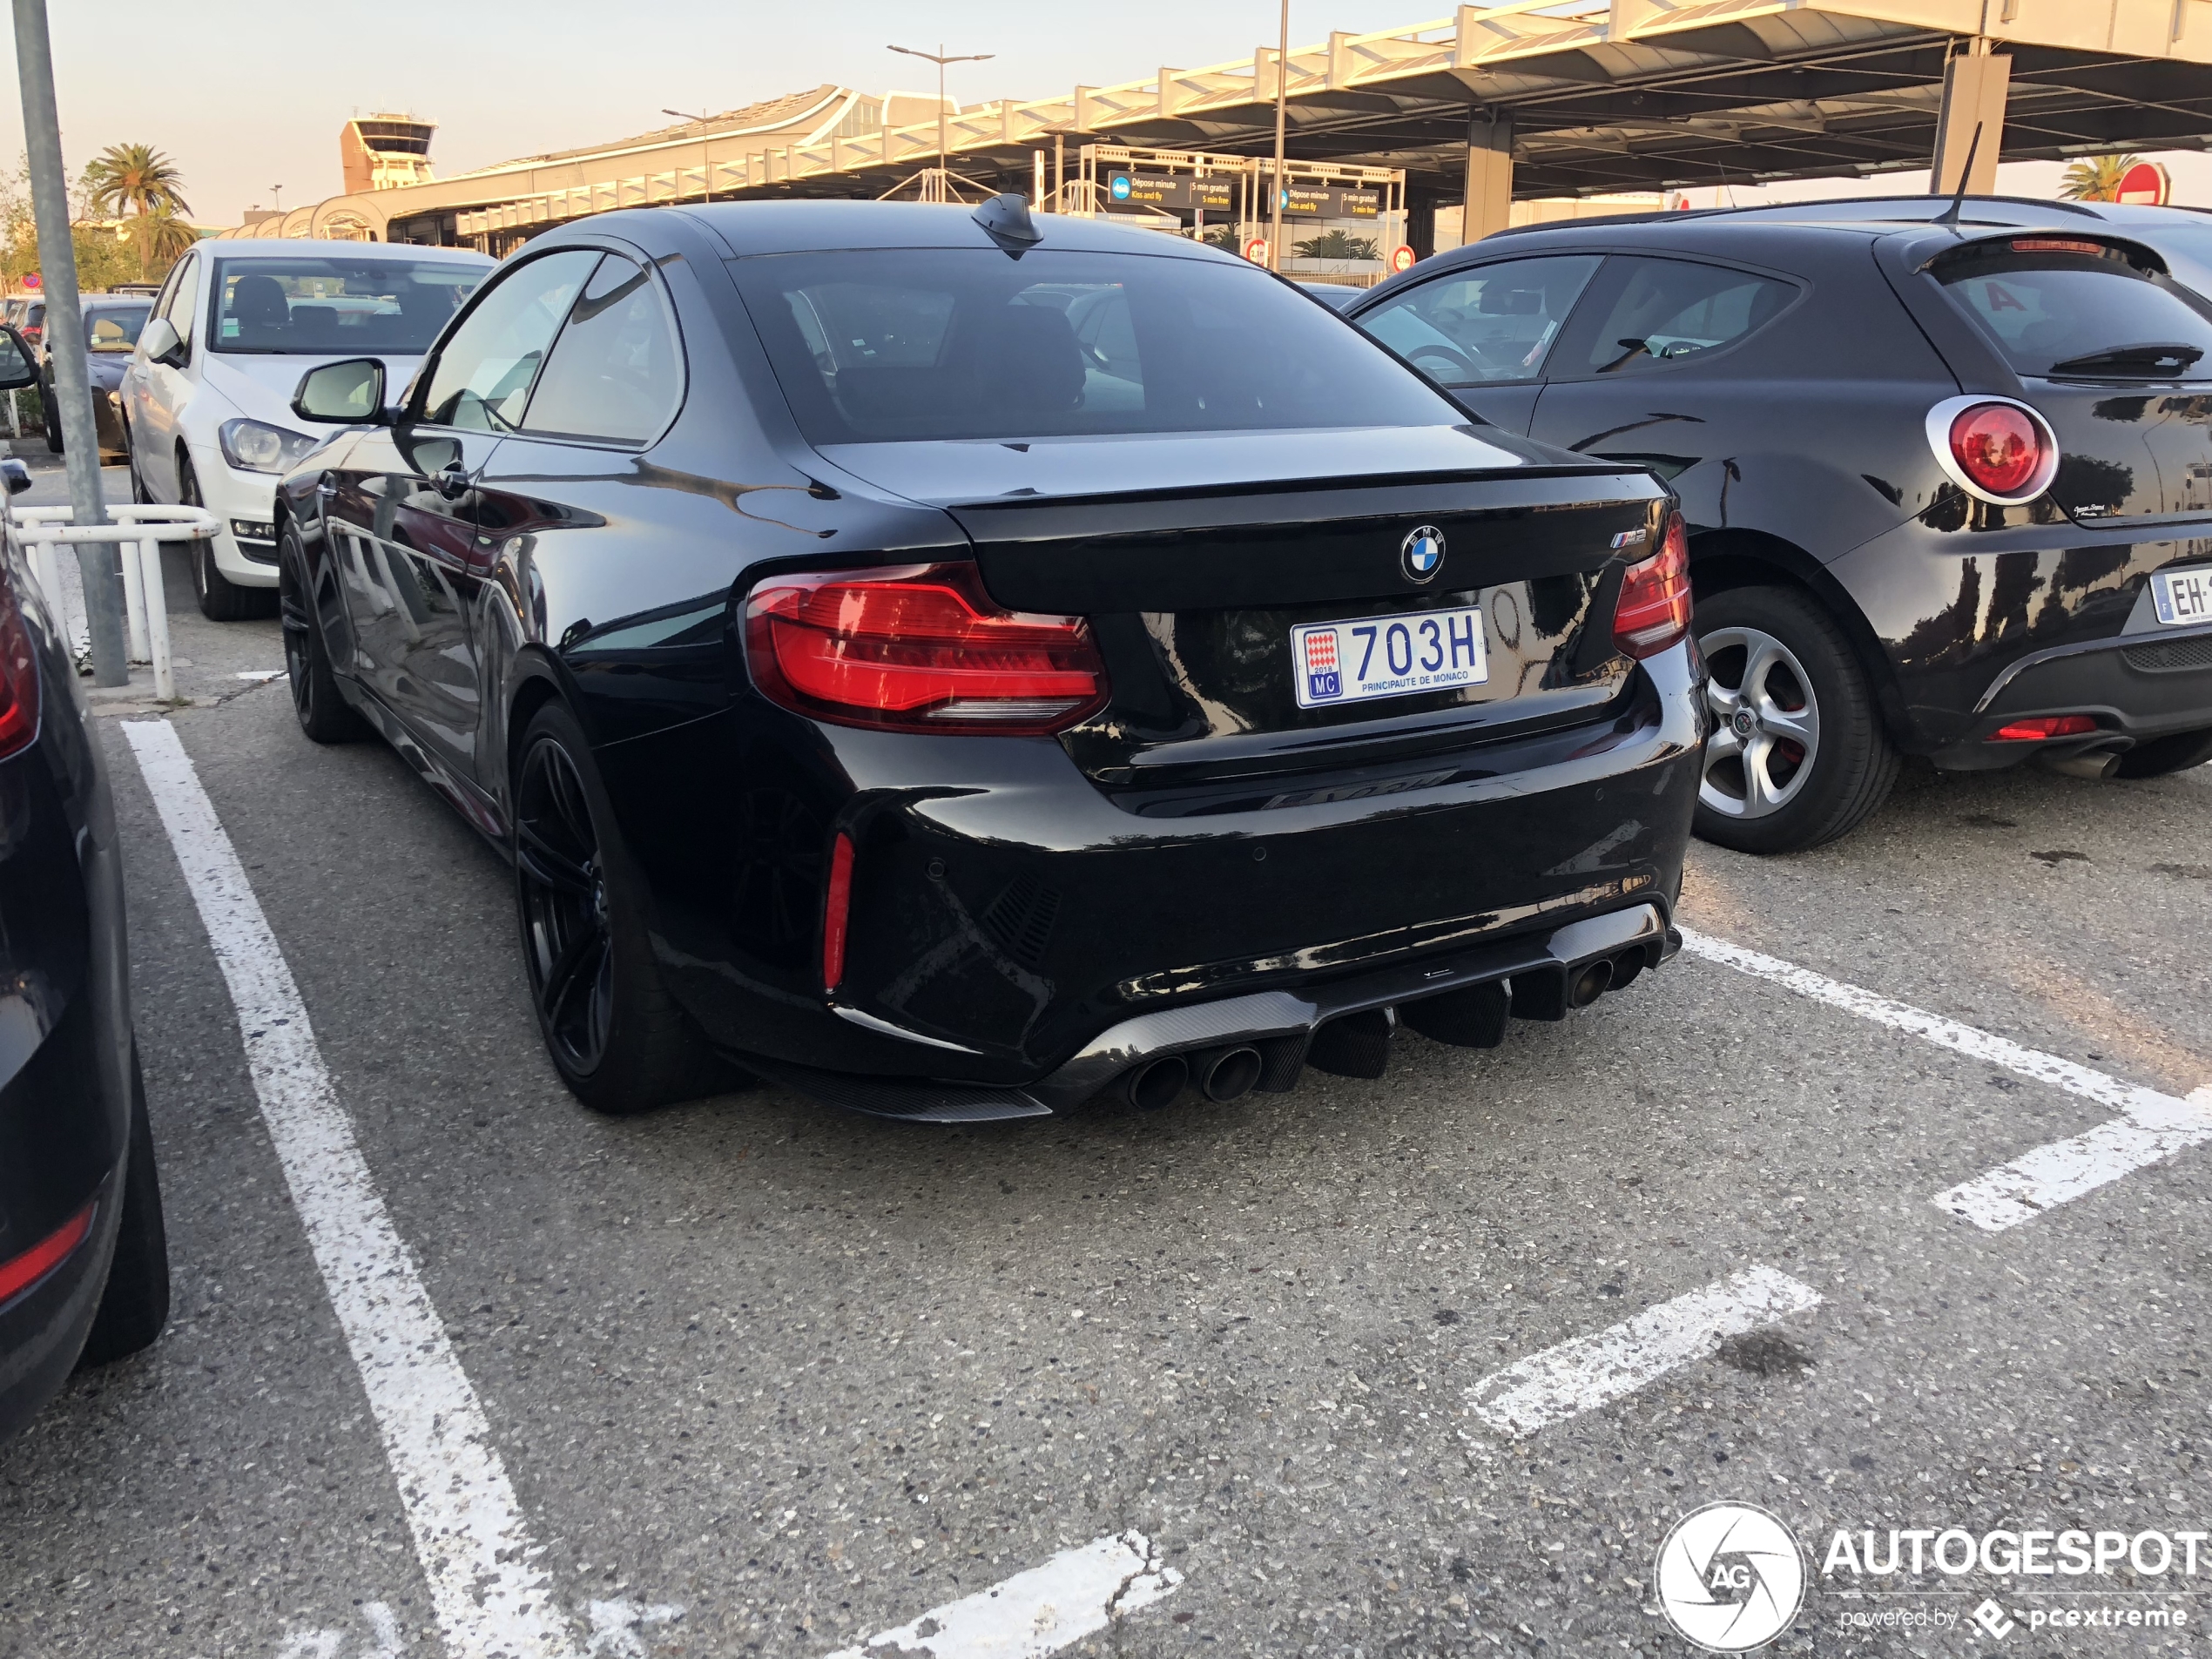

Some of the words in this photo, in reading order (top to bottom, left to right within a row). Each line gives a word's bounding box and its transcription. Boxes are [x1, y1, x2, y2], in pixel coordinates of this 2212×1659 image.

[1132, 178, 1154, 188] Dépose
[1156, 180, 1177, 189] minute
[1210, 184, 1230, 193] gratuit
[1289, 190, 1310, 199] Dépose
[1311, 192, 1329, 200] minute
[1359, 195, 1377, 204] gratuit
[1985, 282, 2027, 311] A
[1408, 527, 1443, 546] BMW
[2172, 577, 2212, 616] EH-
[2161, 603, 2168, 613] F
[1352, 615, 1475, 681] 703H
[1315, 675, 1335, 694] MC
[1362, 678, 1416, 692] PRINCIPAUTE
[1420, 675, 1431, 685] DE
[1433, 671, 1468, 683] MONACO
